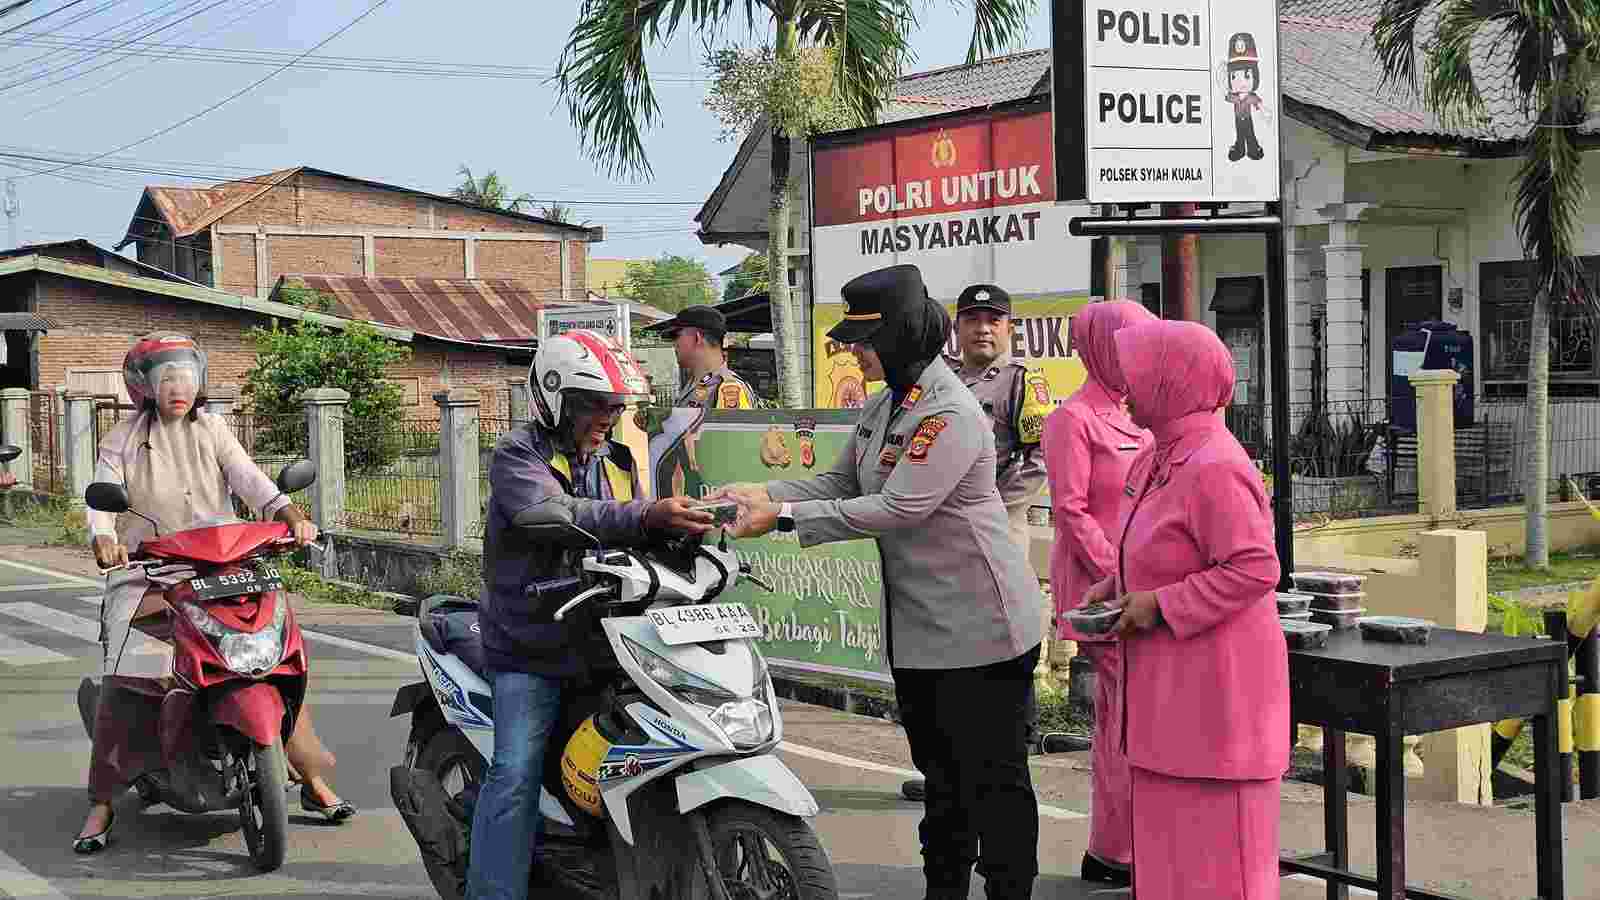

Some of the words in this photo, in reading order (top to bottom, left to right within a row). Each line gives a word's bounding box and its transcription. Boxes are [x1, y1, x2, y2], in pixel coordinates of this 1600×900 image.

[1097, 9, 1201, 46] POLISI
[1098, 92, 1203, 124] POLICE
[1099, 168, 1138, 182] POLSEK
[1140, 168, 1169, 182] SYIAH
[1171, 168, 1204, 182] KUALA
[858, 179, 933, 216] POLRI
[941, 164, 1042, 205] UNTUK
[860, 211, 1042, 256] MASYARAKAT
[192, 577, 213, 592] BL
[219, 570, 257, 586] 5332
[651, 610, 675, 626] BL
[717, 604, 749, 619] AAA
[653, 717, 688, 741] HONDA
